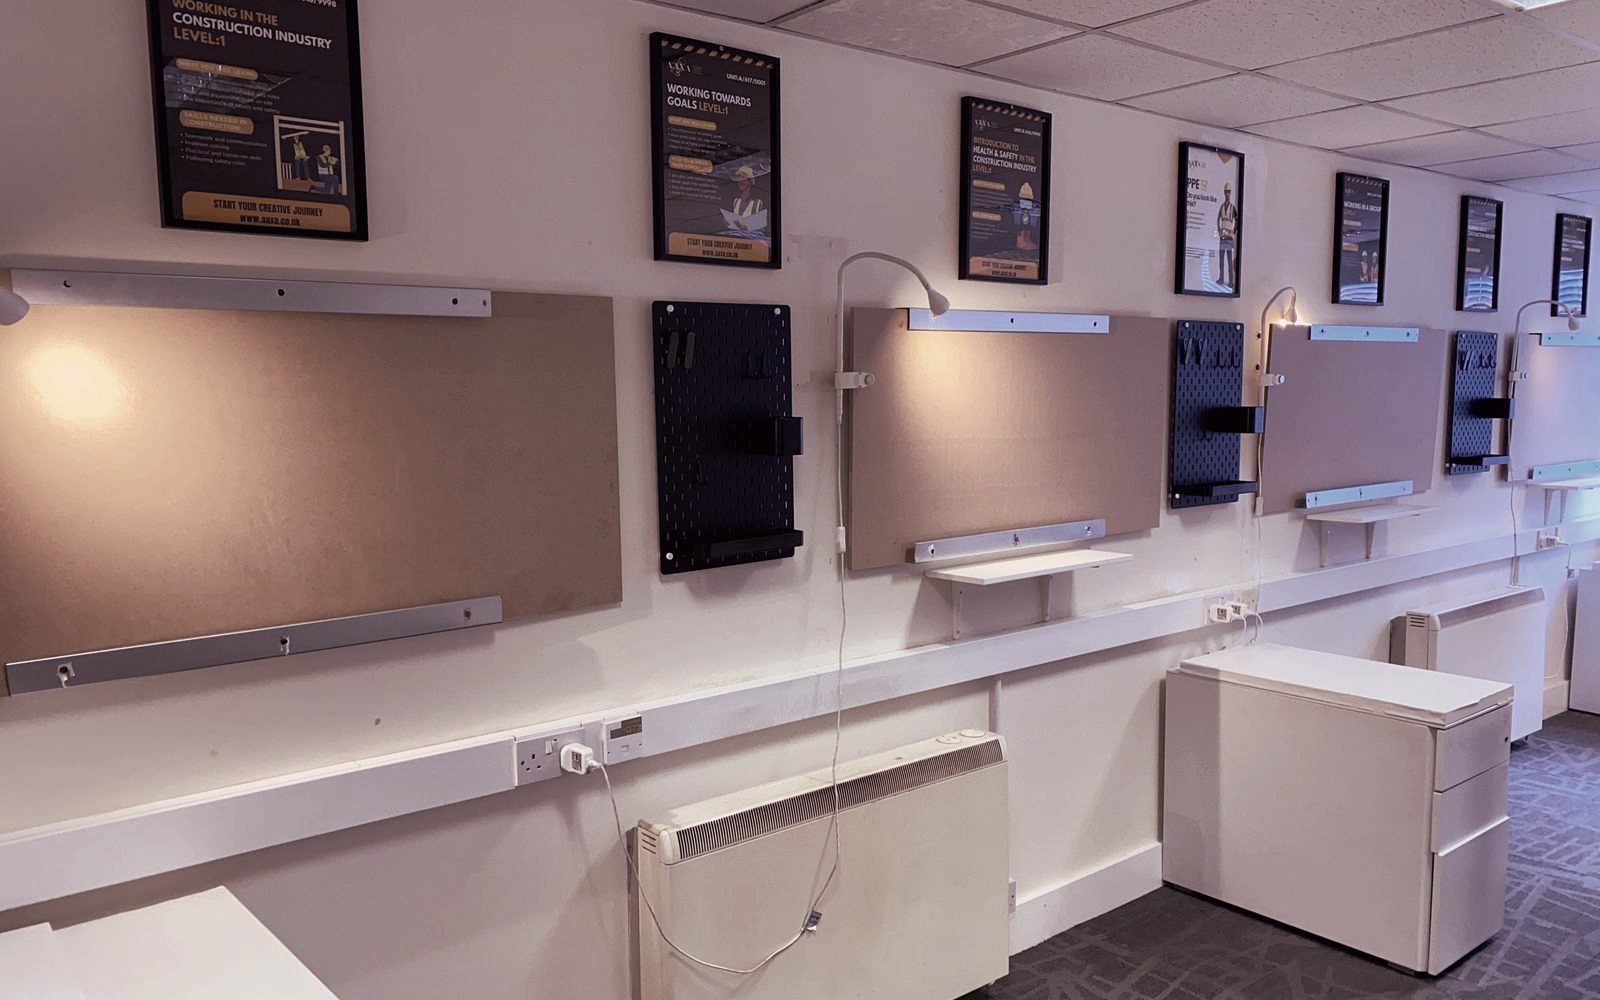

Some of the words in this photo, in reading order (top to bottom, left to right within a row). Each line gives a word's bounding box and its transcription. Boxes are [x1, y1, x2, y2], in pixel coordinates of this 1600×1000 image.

[172, 0, 238, 18] WORKING
[240, 11, 254, 21] IN
[256, 12, 279, 26] THE
[172, 12, 273, 39] CONSTRUCTION
[275, 30, 332, 49] INDUSTRY
[173, 27, 226, 46] LEVEL:1
[667, 83, 710, 100] WORKING
[712, 92, 752, 107] TOWARDS
[668, 96, 698, 110] GOALS
[699, 102, 728, 115] LEVEL:1
[973, 146, 993, 156] HEALTH
[1000, 150, 1018, 160] SAFETY
[974, 136, 1011, 150] INTRODUCTION
[1012, 144, 1019, 152] TO
[973, 155, 1012, 169] CONSTRUCTION
[1013, 162, 1037, 172] INDUSTRY
[214, 199, 236, 210] START
[238, 202, 256, 211] YOUR
[258, 204, 291, 214] CREATIVE
[293, 206, 322, 216] JOURNEY
[240, 214, 300, 226] www.aaxa.co.uk
